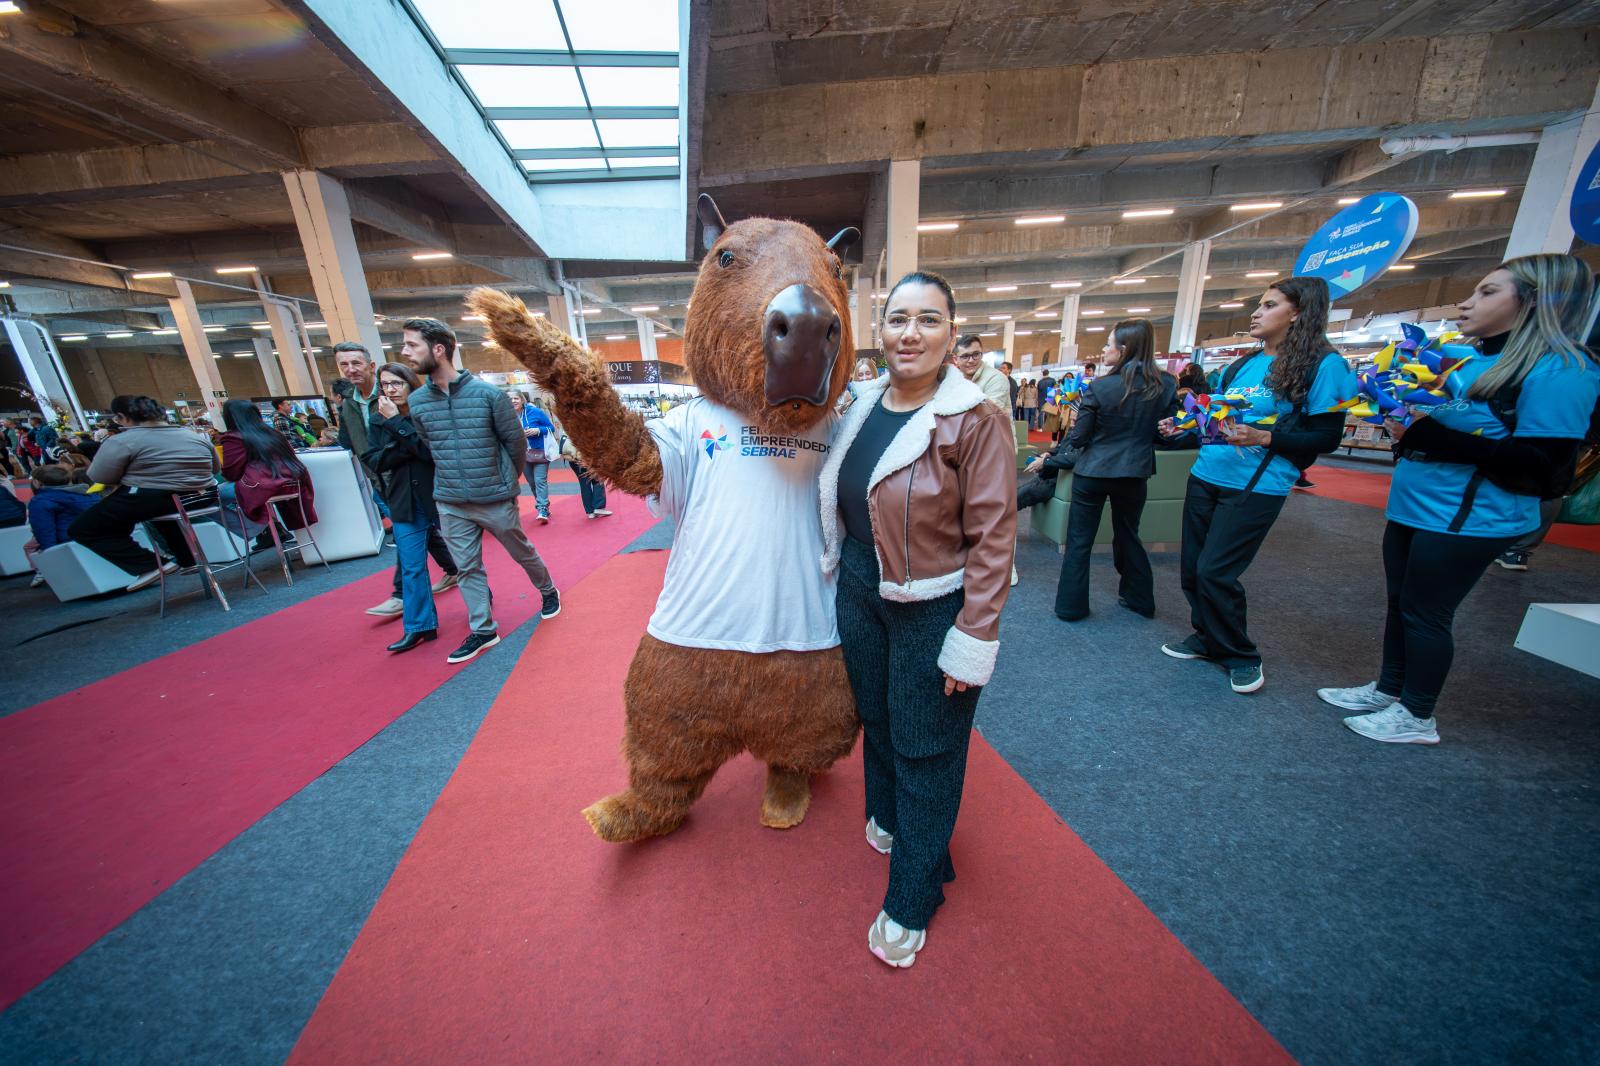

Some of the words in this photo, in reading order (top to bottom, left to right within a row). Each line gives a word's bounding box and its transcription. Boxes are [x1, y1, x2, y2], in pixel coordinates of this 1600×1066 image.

[741, 425, 760, 435] FEI
[740, 435, 833, 455] EMPREENDED
[741, 446, 798, 459] SEBRAE
